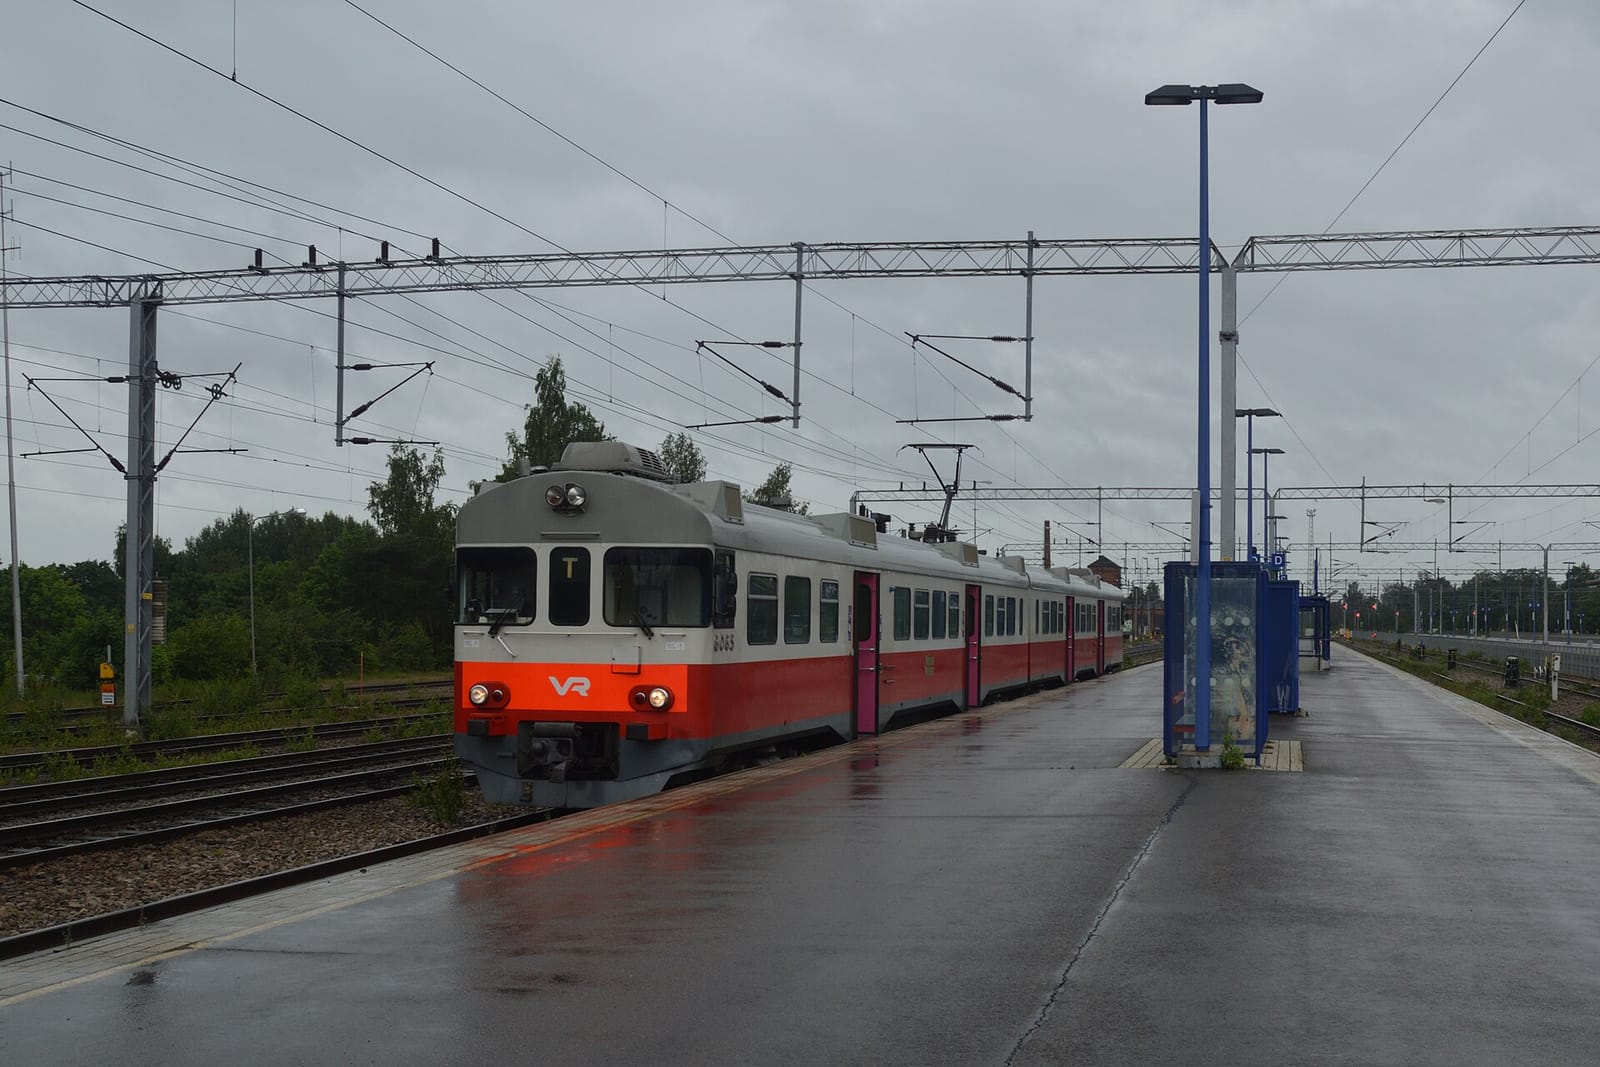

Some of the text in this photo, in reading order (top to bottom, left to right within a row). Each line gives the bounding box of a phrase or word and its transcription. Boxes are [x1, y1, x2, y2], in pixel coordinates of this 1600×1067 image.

[562, 557, 579, 579] T
[1274, 556, 1283, 565] D
[548, 676, 591, 697] VR
